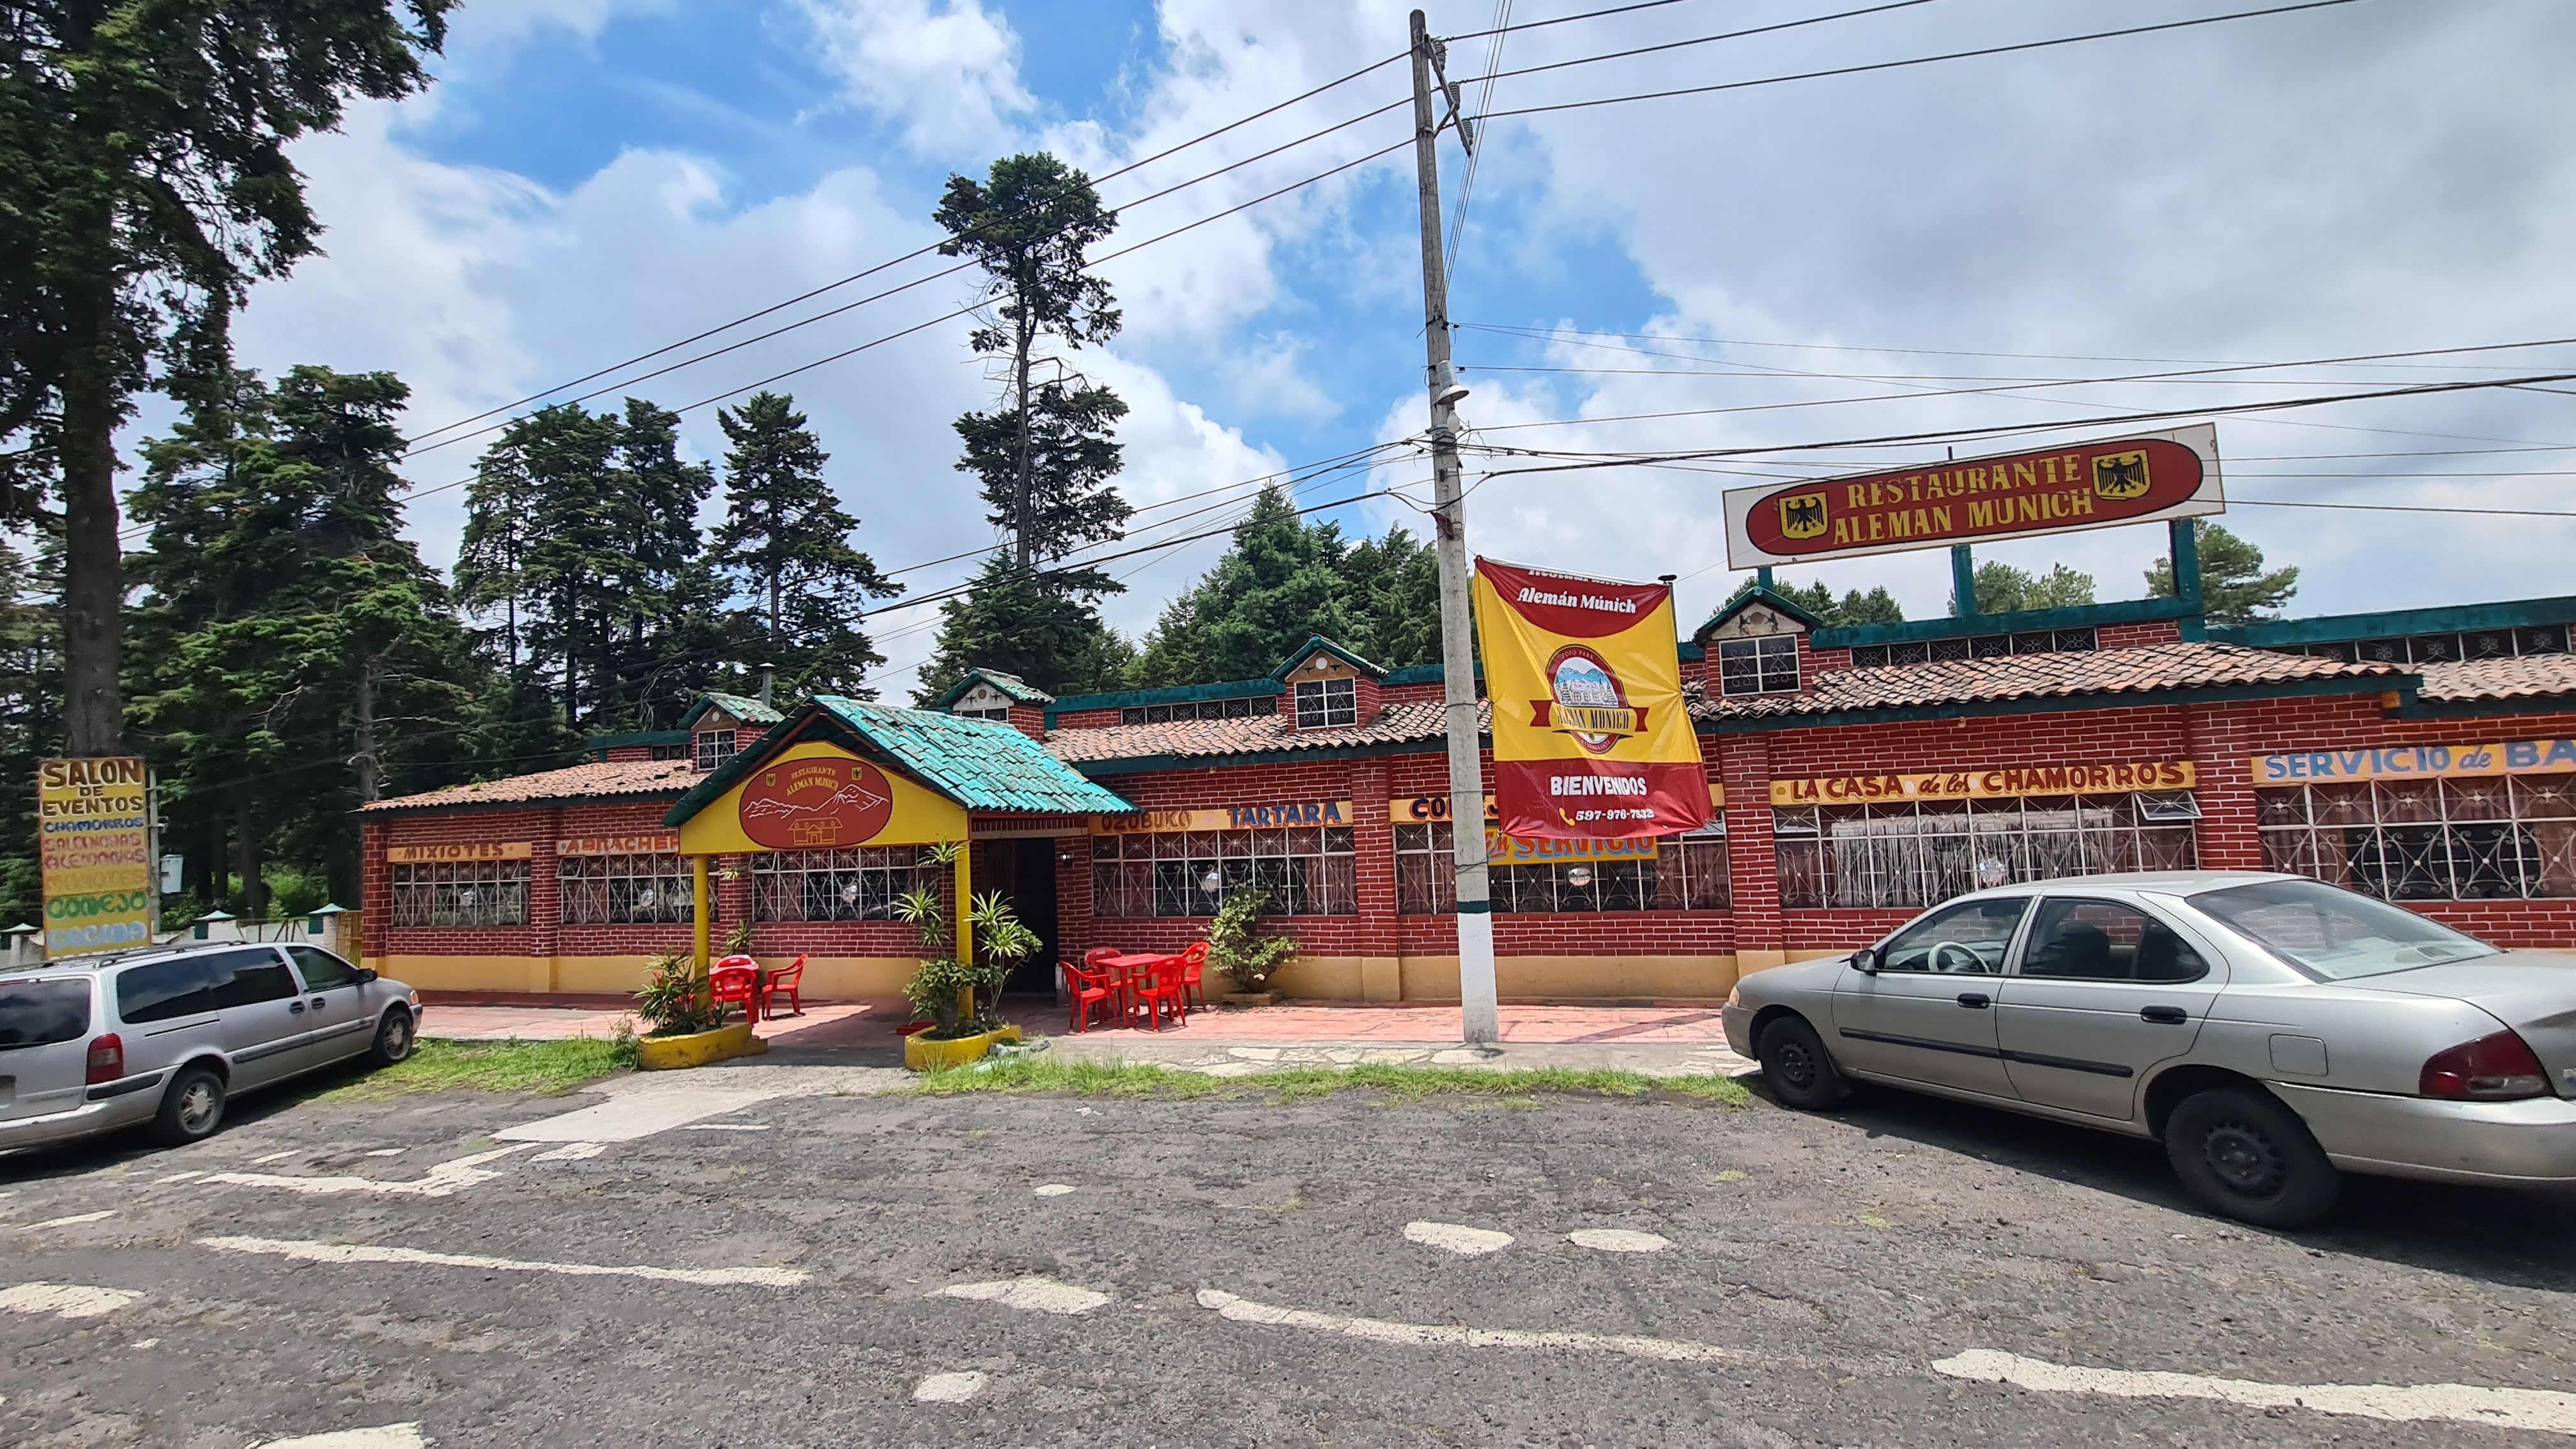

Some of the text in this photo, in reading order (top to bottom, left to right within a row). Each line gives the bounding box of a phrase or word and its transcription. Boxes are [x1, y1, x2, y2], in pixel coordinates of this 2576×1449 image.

[1846, 454, 2082, 509] RESTAURANTE
[1832, 487, 2096, 545] ALEMAN MUNICH
[1517, 588, 1636, 614] Alemán Múnich
[1590, 710, 1629, 729] MUNICH
[43, 759, 141, 788] SALON
[2266, 746, 2450, 778] SERVICIO
[2459, 744, 2492, 769] de
[79, 786, 103, 797] DE
[1551, 776, 1648, 796] BIENVENIDOS
[1791, 761, 2185, 800] LA CASA de los CHAMORROS
[43, 796, 144, 816] EVENTOS
[1227, 802, 1342, 829] TARTARA
[45, 817, 144, 832] CHAMORROS
[404, 842, 503, 859] MIXIOTES
